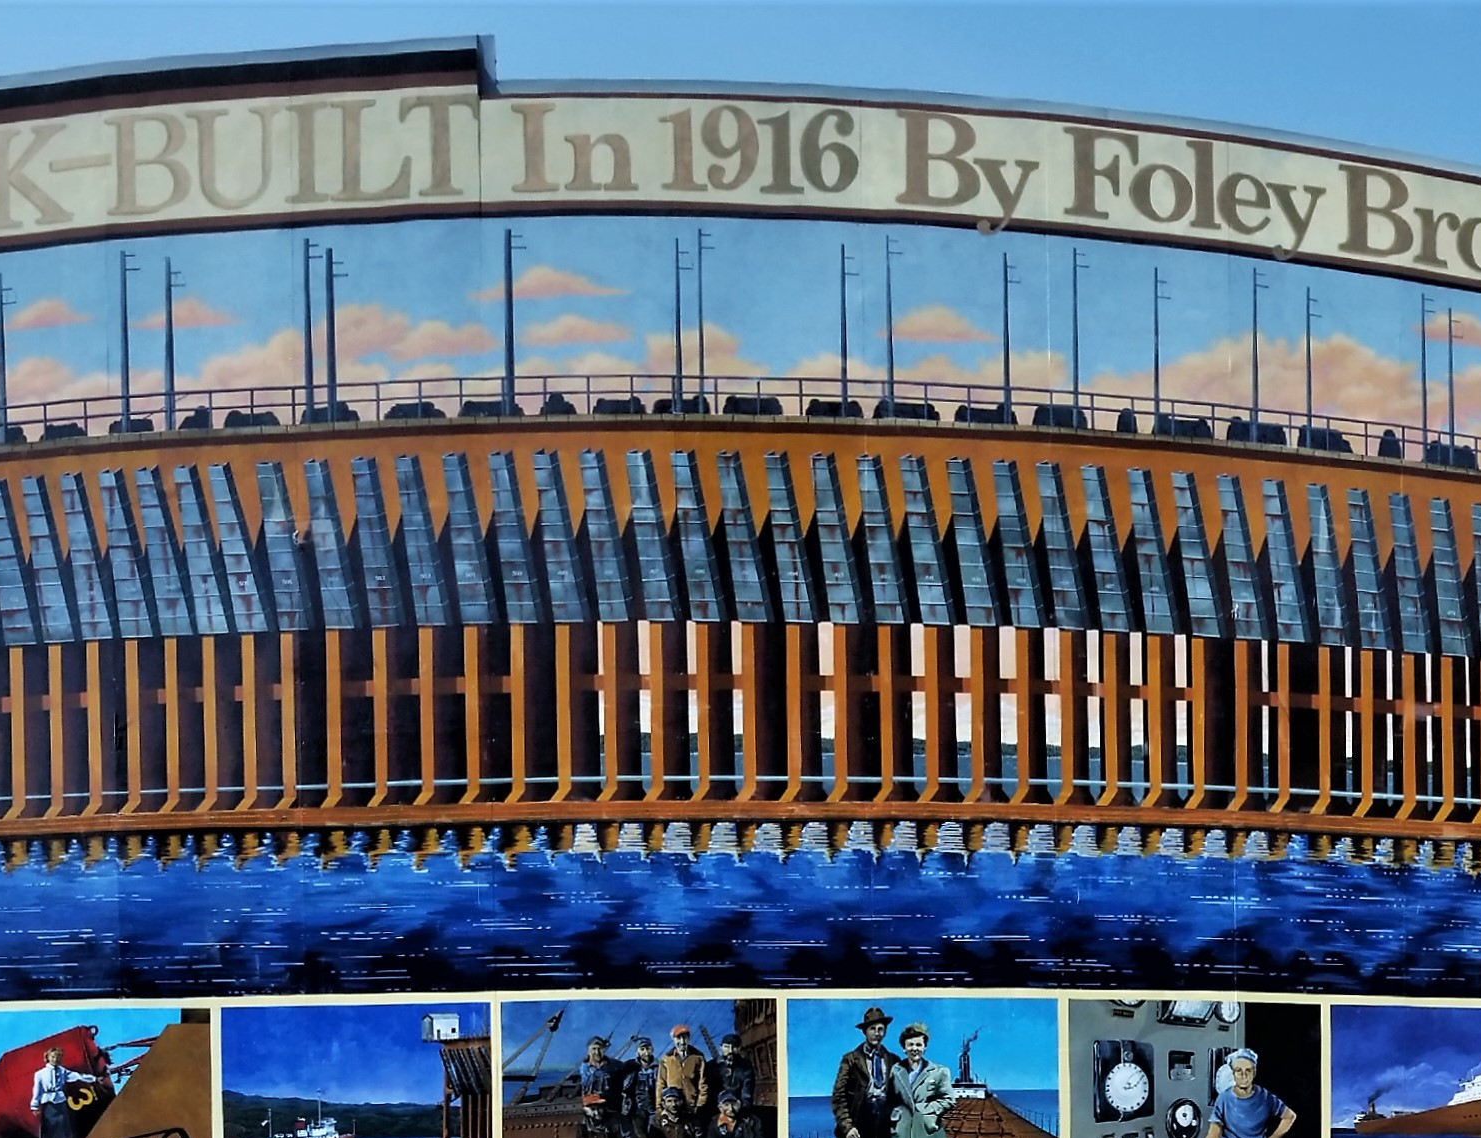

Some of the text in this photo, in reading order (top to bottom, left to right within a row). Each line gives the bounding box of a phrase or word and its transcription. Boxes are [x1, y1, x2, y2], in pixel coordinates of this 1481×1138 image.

[510, 102, 638, 195] In
[657, 104, 860, 196] 1916
[894, 109, 1039, 236] By
[1063, 125, 1326, 261] Foley
